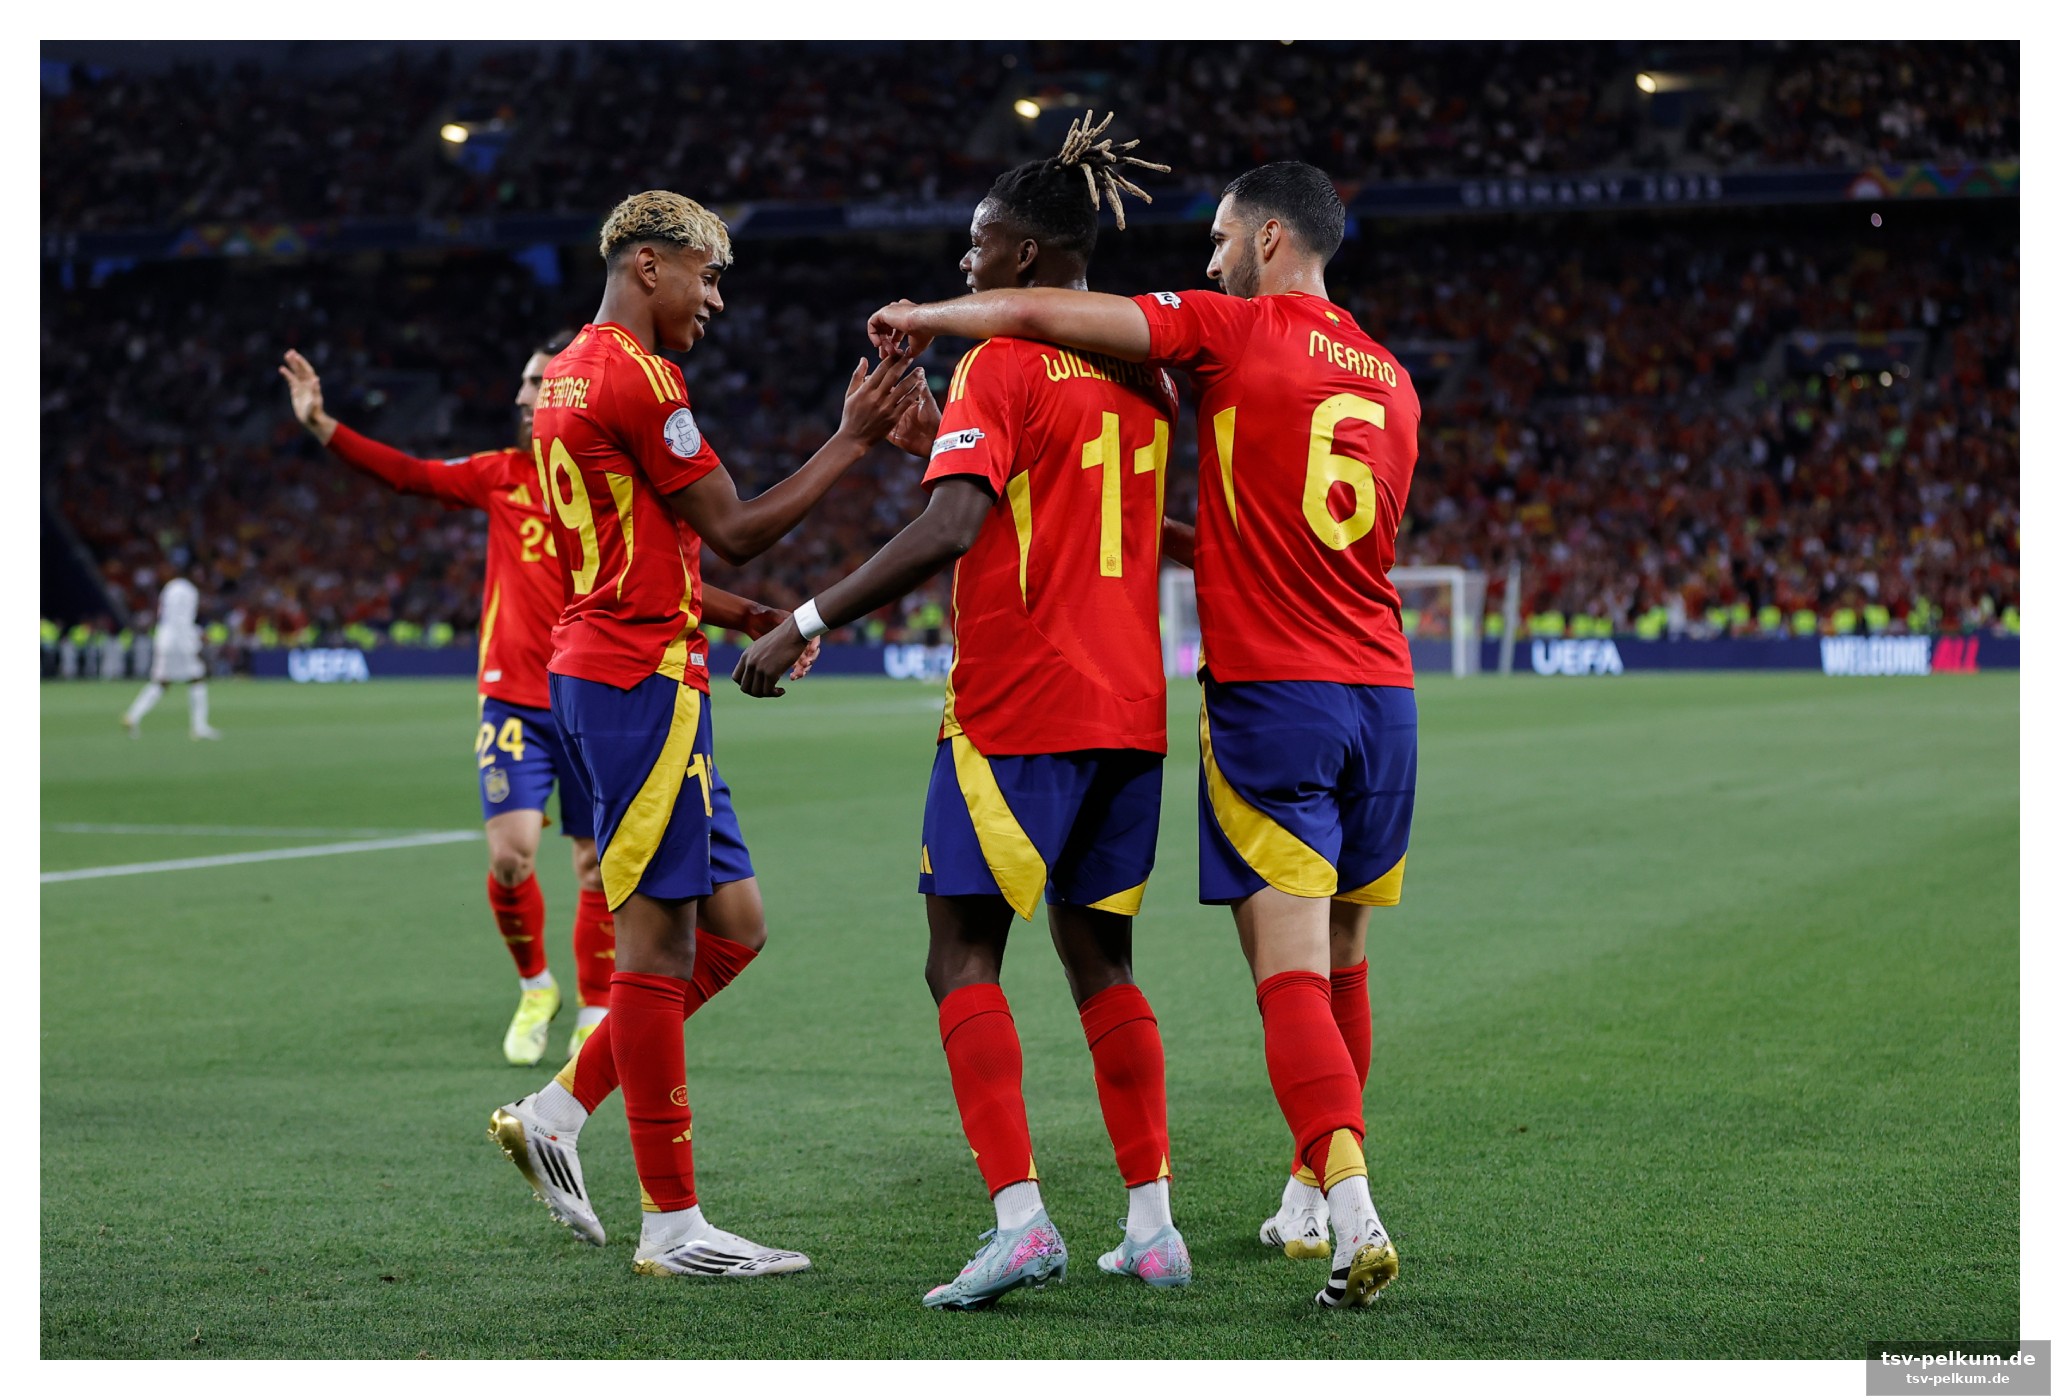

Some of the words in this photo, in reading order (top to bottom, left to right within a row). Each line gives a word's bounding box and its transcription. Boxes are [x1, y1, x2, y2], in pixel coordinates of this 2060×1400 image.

[1308, 329, 1398, 388] MERINO
[1081, 410, 1169, 578] 11
[1302, 393, 1386, 551] 6
[287, 648, 370, 682] UEFA
[1531, 638, 1624, 676] UEFA
[1820, 635, 1932, 676] WELCOME
[474, 716, 526, 769] 24
